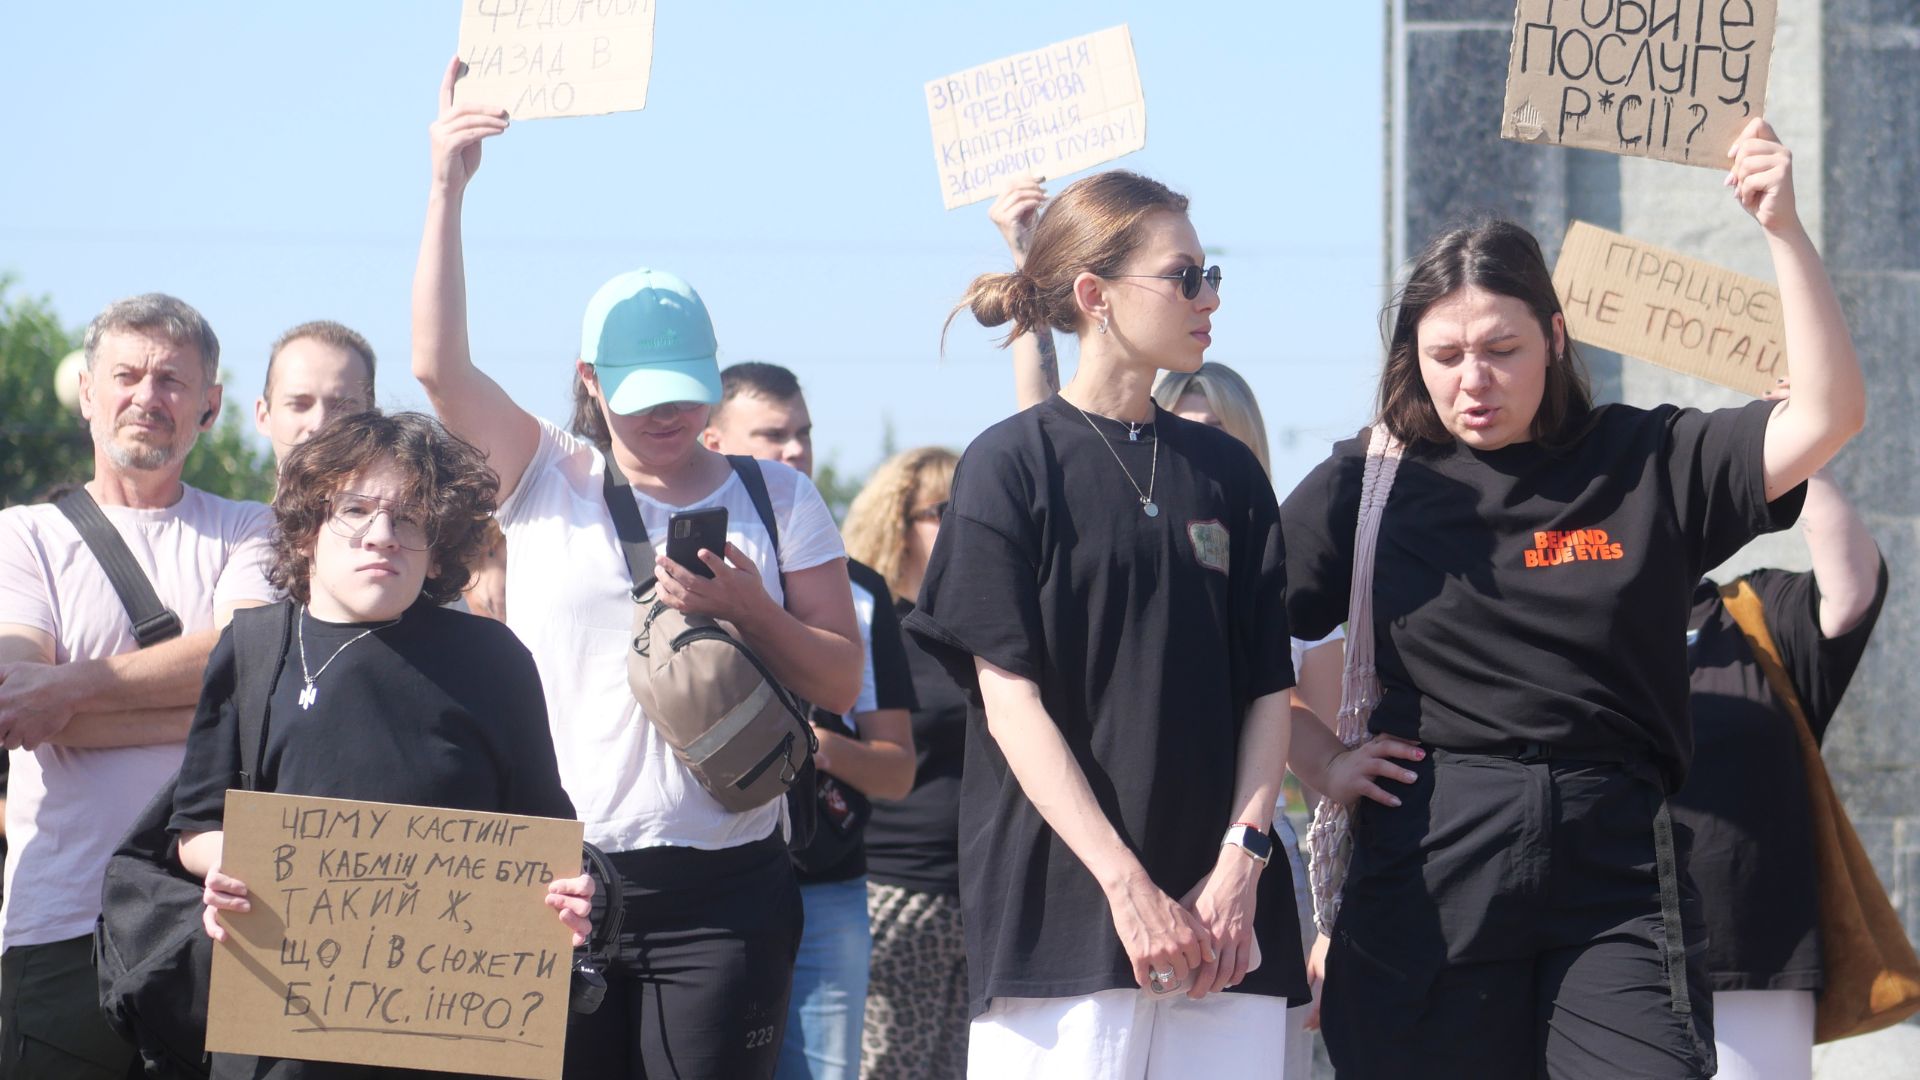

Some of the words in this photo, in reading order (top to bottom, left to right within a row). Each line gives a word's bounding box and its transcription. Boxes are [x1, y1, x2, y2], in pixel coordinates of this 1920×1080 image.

[467, 41, 566, 78] НАЗАД
[592, 36, 612, 70] В
[931, 40, 1092, 110] ЗВІЛЬНЕННЯ
[513, 81, 576, 114] МО
[963, 72, 1086, 128] ФЕДОРОВА
[941, 103, 1082, 167] КАПІТУЛЯЦІЯ
[948, 146, 1046, 196] ЗДОРОВОГО
[1055, 108, 1137, 161] ГЛУЗДУ!
[1605, 242, 1777, 325] ПРАЦЮЄ
[1564, 279, 1624, 325] НЕ
[1644, 302, 1781, 377] ТРОГАЙ
[1524, 547, 1575, 568] BLUE
[1575, 542, 1624, 561] EYES
[1534, 528, 1608, 549] BEHIND
[281, 807, 391, 840] ЧОМУ
[407, 814, 530, 847] КАСТИНГ
[273, 844, 297, 882] В
[424, 853, 487, 880] МАЄ
[495, 860, 554, 887] БУТЬ
[281, 881, 421, 928] ТАКИЙ
[438, 889, 474, 934] Ж,
[280, 937, 341, 970] ЩО
[387, 934, 405, 969] В
[416, 944, 557, 979] СЮЖЕТИ
[745, 1025, 774, 1049] 223
